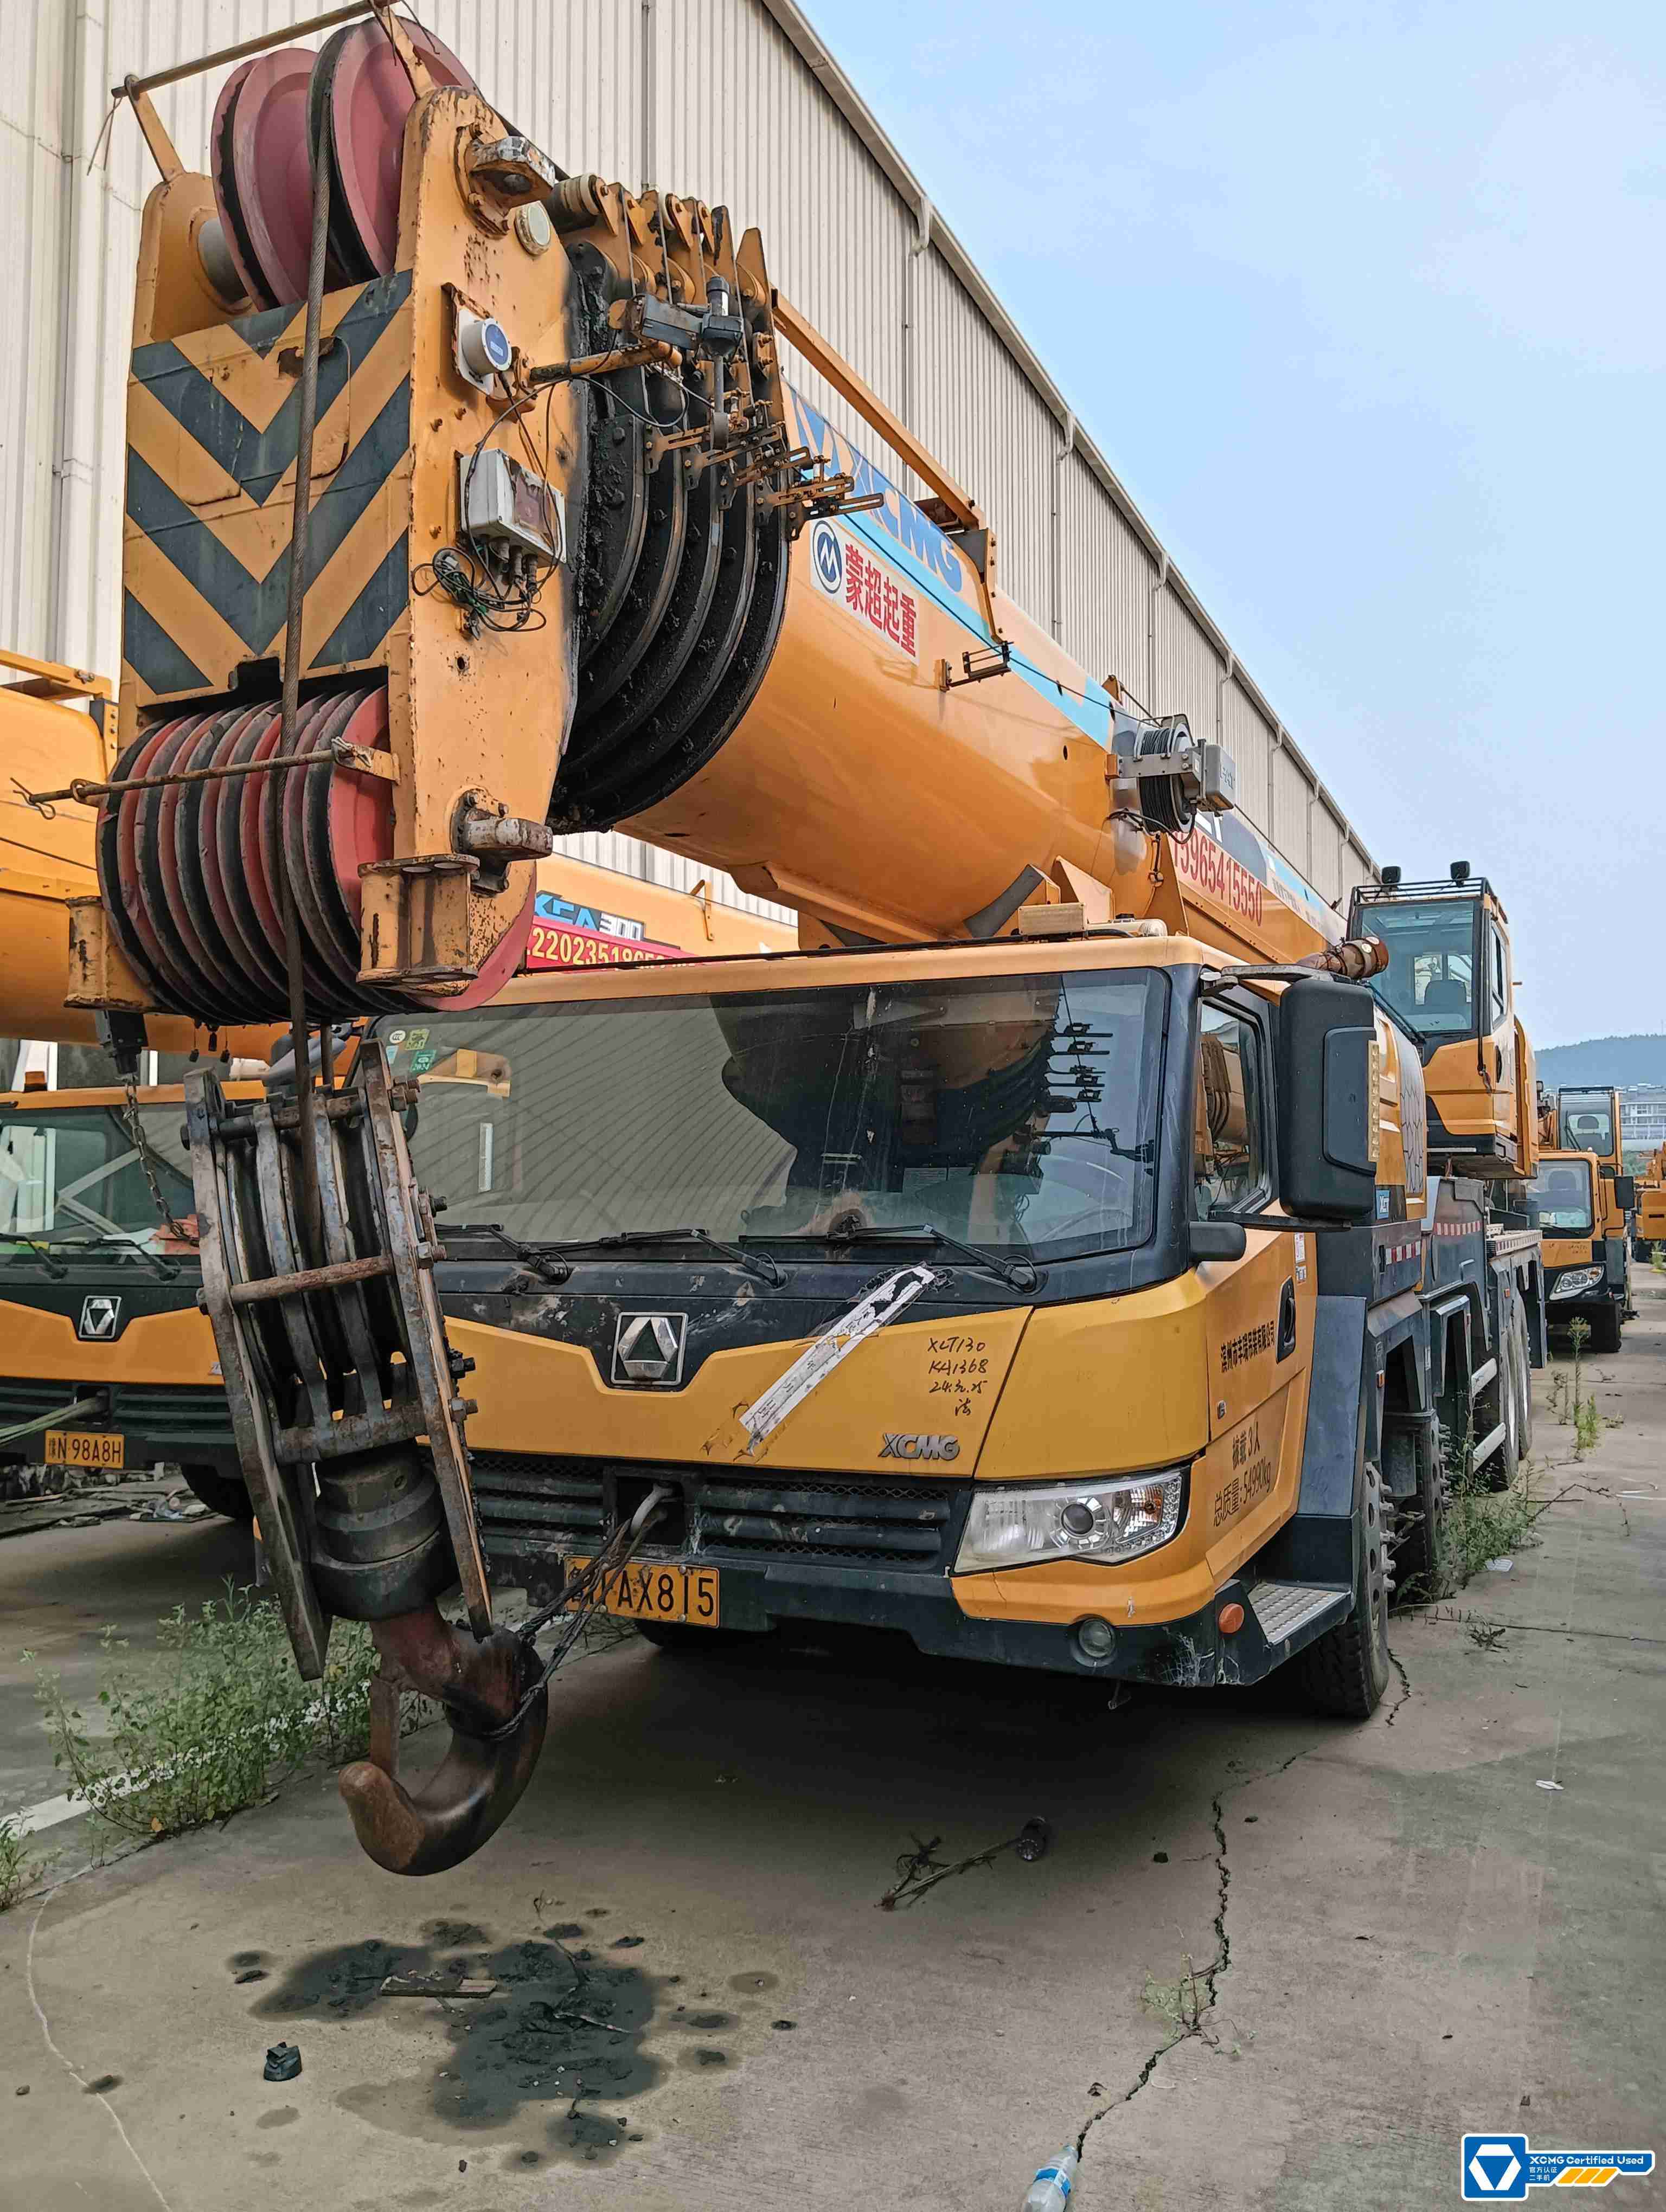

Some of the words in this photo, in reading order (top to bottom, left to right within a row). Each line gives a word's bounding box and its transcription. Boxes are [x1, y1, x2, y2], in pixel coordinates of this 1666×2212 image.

[845, 543, 917, 658] 蒙超起重
[878, 1433, 960, 1461] XCMG
